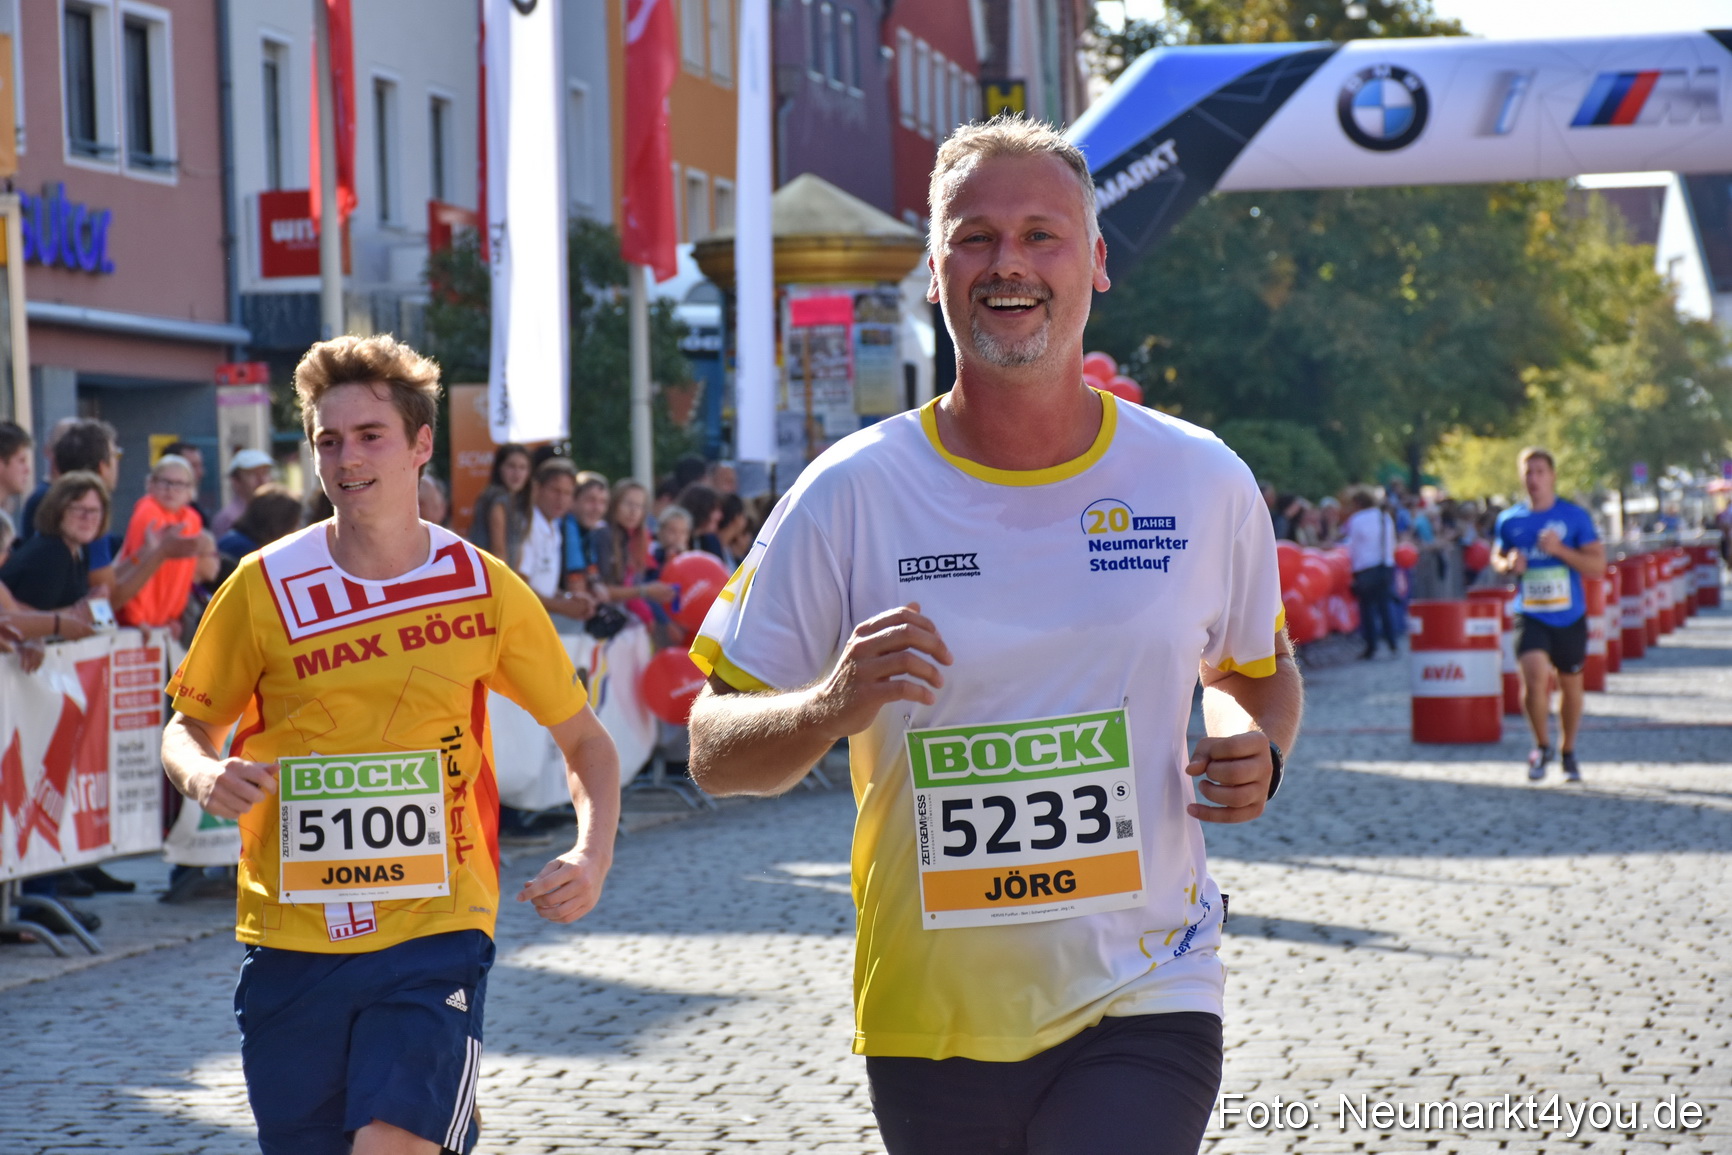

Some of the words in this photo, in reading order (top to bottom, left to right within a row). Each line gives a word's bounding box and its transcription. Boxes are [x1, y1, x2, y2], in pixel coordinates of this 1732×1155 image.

[987, 84, 1024, 117] H
[1087, 508, 1130, 534] 20
[1136, 518, 1173, 530] JAHRE
[1088, 536, 1189, 552] Neumarkter
[899, 553, 980, 576] BOCK
[1089, 556, 1171, 573] Stadtlauf
[292, 633, 388, 680] MAX
[397, 612, 497, 652] BÖGL
[926, 721, 1109, 778] BOCK
[292, 759, 427, 795] BOCK
[299, 804, 427, 852] 5100
[942, 785, 1111, 857] 5233
[321, 863, 405, 885] JONAS
[985, 870, 1077, 901] JÖRG
[445, 997, 468, 1012] adidas
